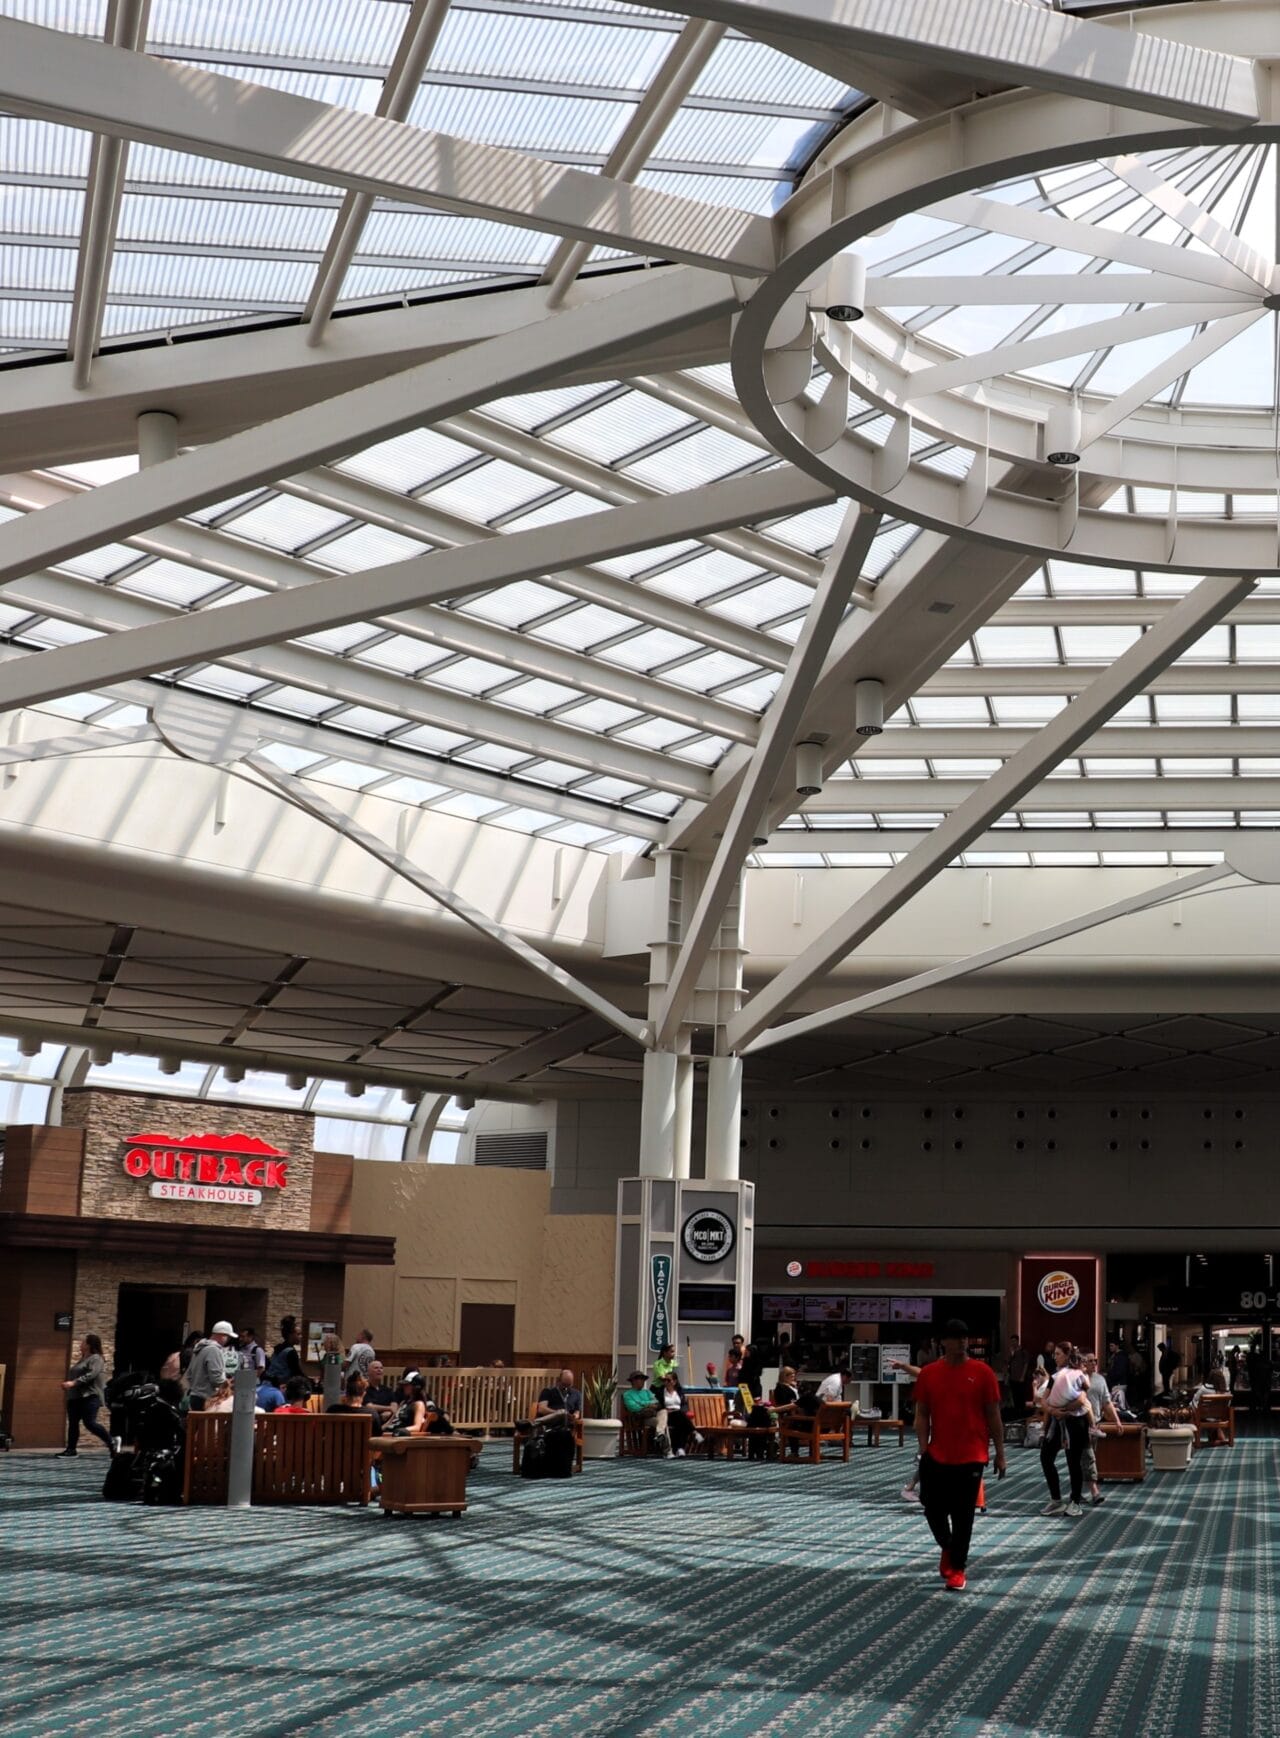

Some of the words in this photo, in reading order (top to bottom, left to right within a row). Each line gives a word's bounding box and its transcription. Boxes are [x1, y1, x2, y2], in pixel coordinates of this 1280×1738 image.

[125, 1148, 288, 1189] OUTBACK
[160, 1184, 255, 1203] STEAKHOUSE
[1043, 1279, 1074, 1294] BURGER
[1045, 1286, 1075, 1303] KING
